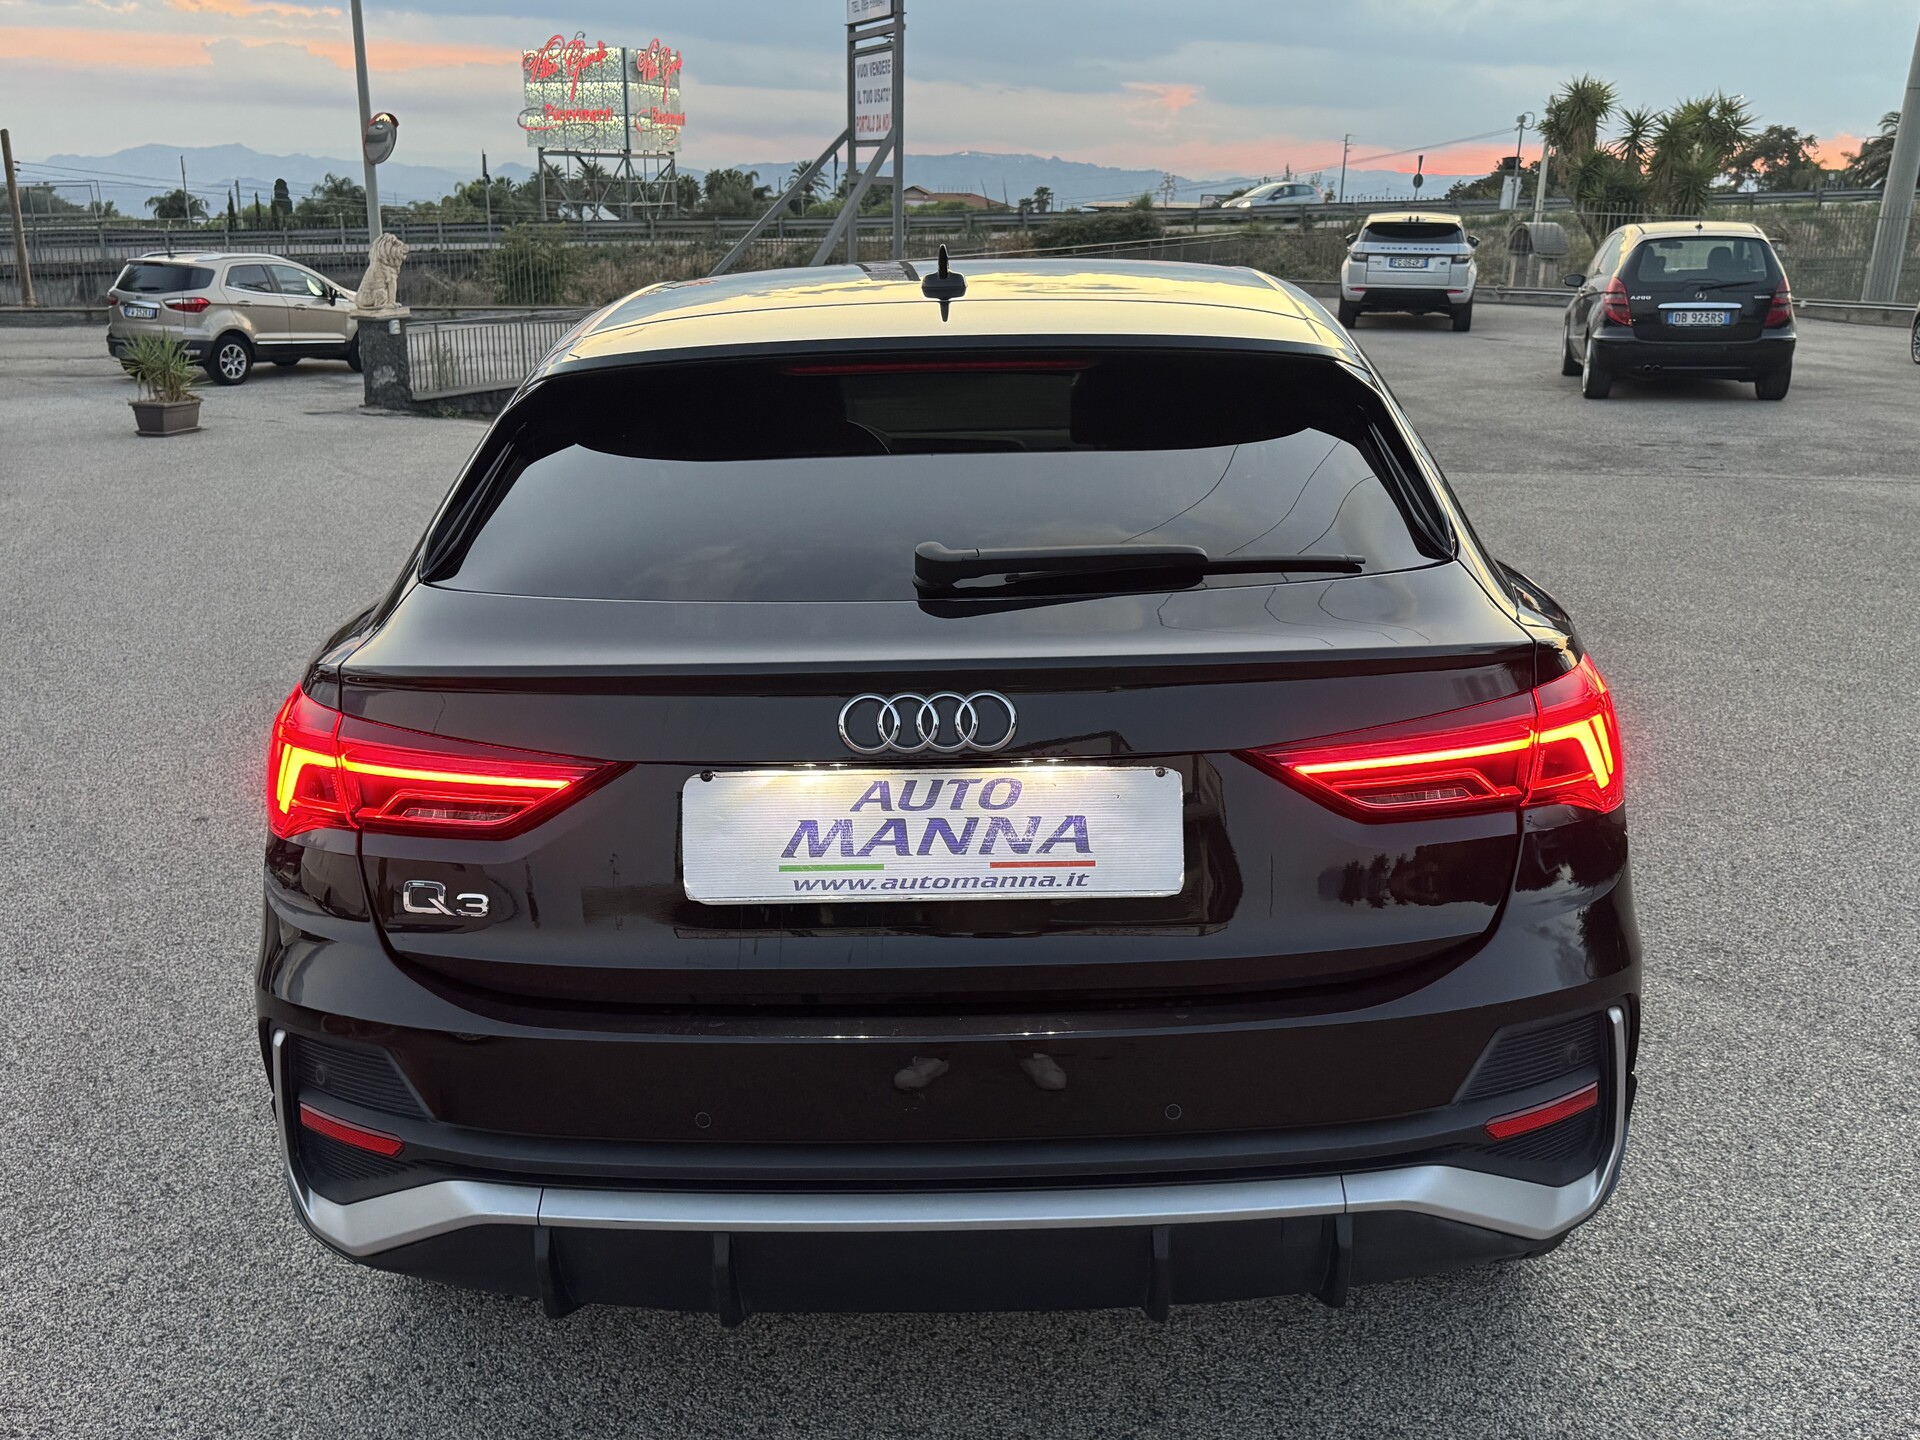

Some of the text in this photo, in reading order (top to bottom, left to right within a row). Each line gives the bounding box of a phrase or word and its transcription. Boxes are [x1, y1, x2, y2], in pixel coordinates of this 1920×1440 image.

[869, 59, 891, 77] VENDERE
[1674, 312, 1724, 323] DB 923RS
[849, 777, 1023, 812] AUTO
[781, 815, 1095, 859] MANNA
[793, 872, 1090, 892] www.automanna.it
[403, 879, 490, 918] Q3
